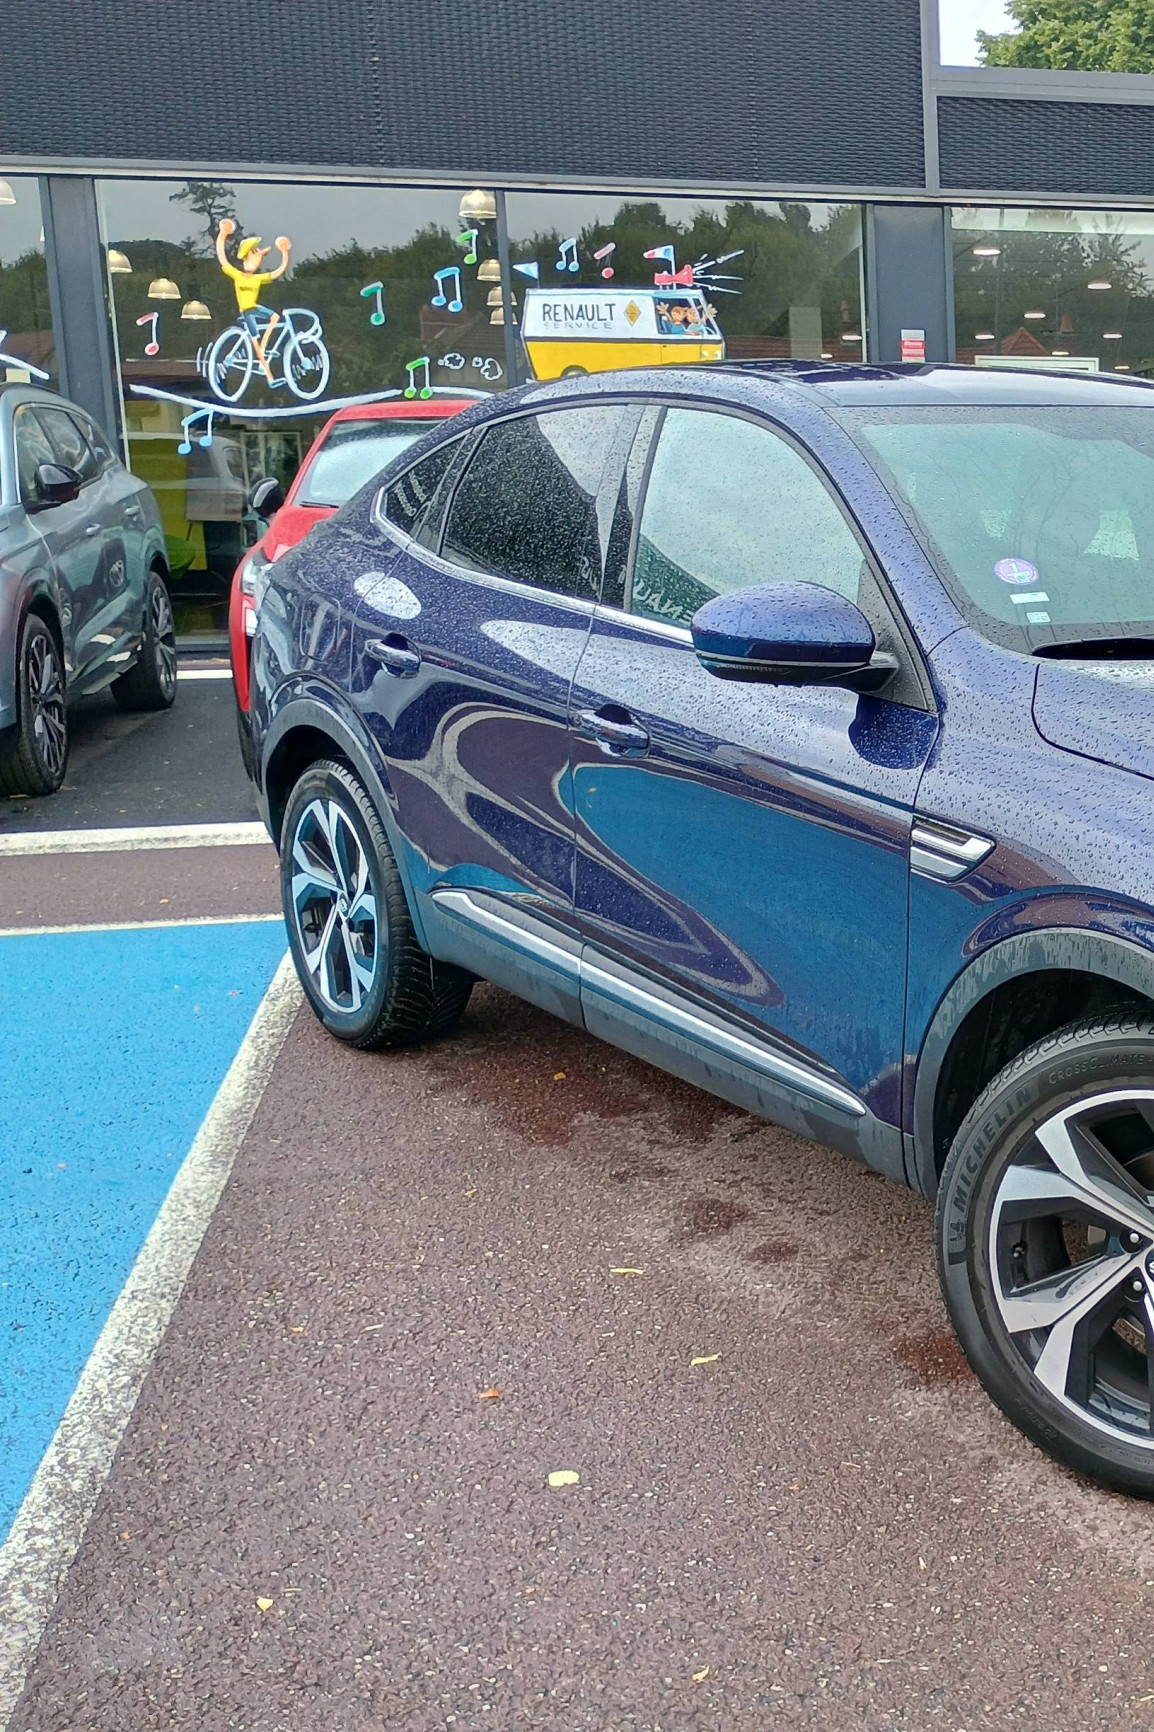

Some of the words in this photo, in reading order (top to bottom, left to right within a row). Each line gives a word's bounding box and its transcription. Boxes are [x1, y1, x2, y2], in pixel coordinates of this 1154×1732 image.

[542, 303, 616, 322] RENAULT
[543, 321, 613, 330] SERVICE
[953, 1084, 1038, 1214] MICHELIN
